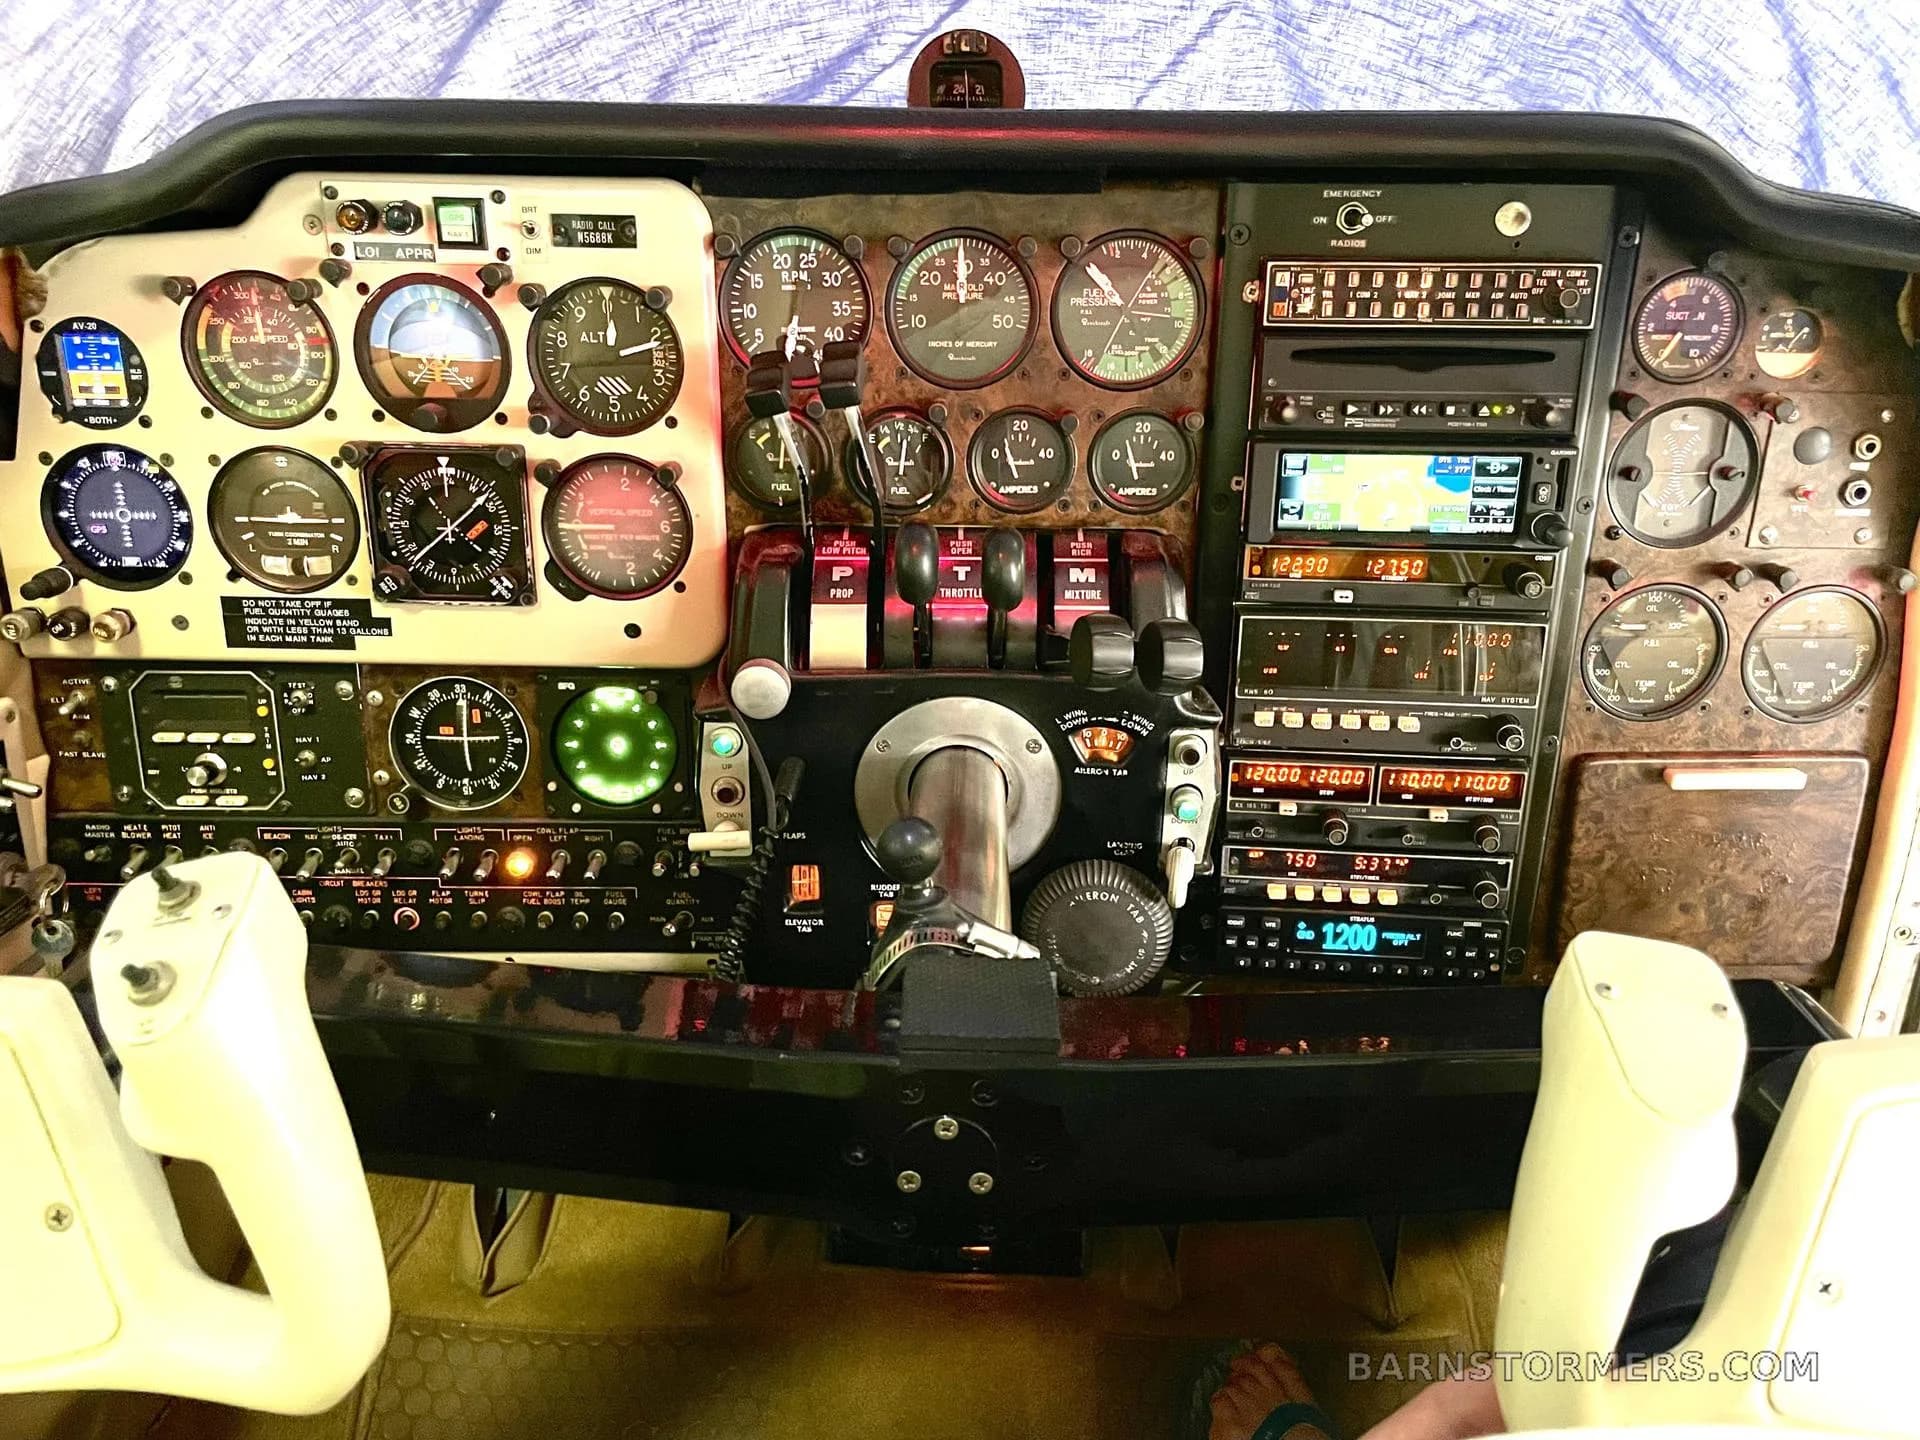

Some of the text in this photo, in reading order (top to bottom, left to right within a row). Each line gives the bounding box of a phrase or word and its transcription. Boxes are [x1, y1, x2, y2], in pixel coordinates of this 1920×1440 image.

[976, 85, 984, 94] 21
[572, 220, 616, 231] RADIO CALL
[396, 248, 433, 260] APPR
[800, 253, 817, 268] 25
[773, 254, 791, 269] 20
[935, 258, 946, 266] 25
[980, 258, 990, 266] 35
[750, 274, 763, 289] 15
[822, 272, 841, 287] 30
[920, 271, 941, 285] 20
[984, 272, 1006, 285] 40
[1004, 296, 1015, 304] 45
[574, 307, 585, 323] 9
[743, 304, 757, 319] 10
[832, 301, 850, 316] 35
[72, 322, 97, 330] AV-20
[911, 315, 926, 328] 10
[992, 315, 1013, 328] 50
[1174, 320, 1183, 328] 10
[557, 331, 567, 348] 8
[581, 332, 605, 342] ALT
[754, 328, 764, 344] 5
[824, 327, 844, 341] 40
[560, 363, 570, 379] 7
[653, 370, 664, 386] 3
[579, 385, 590, 401] 6
[637, 386, 649, 401] 4
[609, 396, 620, 412] 5
[1013, 421, 1028, 431] 20
[1135, 422, 1151, 433] 20
[992, 448, 999, 459] 0
[1038, 448, 1054, 459] 40
[1112, 449, 1120, 460] 0
[1159, 451, 1175, 461] 40
[891, 487, 910, 495] FUEL
[999, 486, 1038, 494] AMPERES
[1118, 487, 1157, 496] AMPERES
[90, 525, 107, 534] GPS
[660, 520, 670, 533] 6
[332, 545, 339, 553] R
[832, 566, 854, 581] P
[953, 566, 971, 581] T
[1069, 568, 1096, 583] M
[830, 589, 854, 599] PROP
[940, 588, 983, 598] THROTTL
[1064, 590, 1102, 600] MIXTURE
[428, 689, 440, 700] 30
[454, 684, 466, 693] 33
[1063, 709, 1087, 721] WING
[1132, 714, 1155, 730] WING
[1286, 853, 1316, 867] 750
[1354, 857, 1391, 870] 5:37
[1322, 923, 1377, 951] 1200
